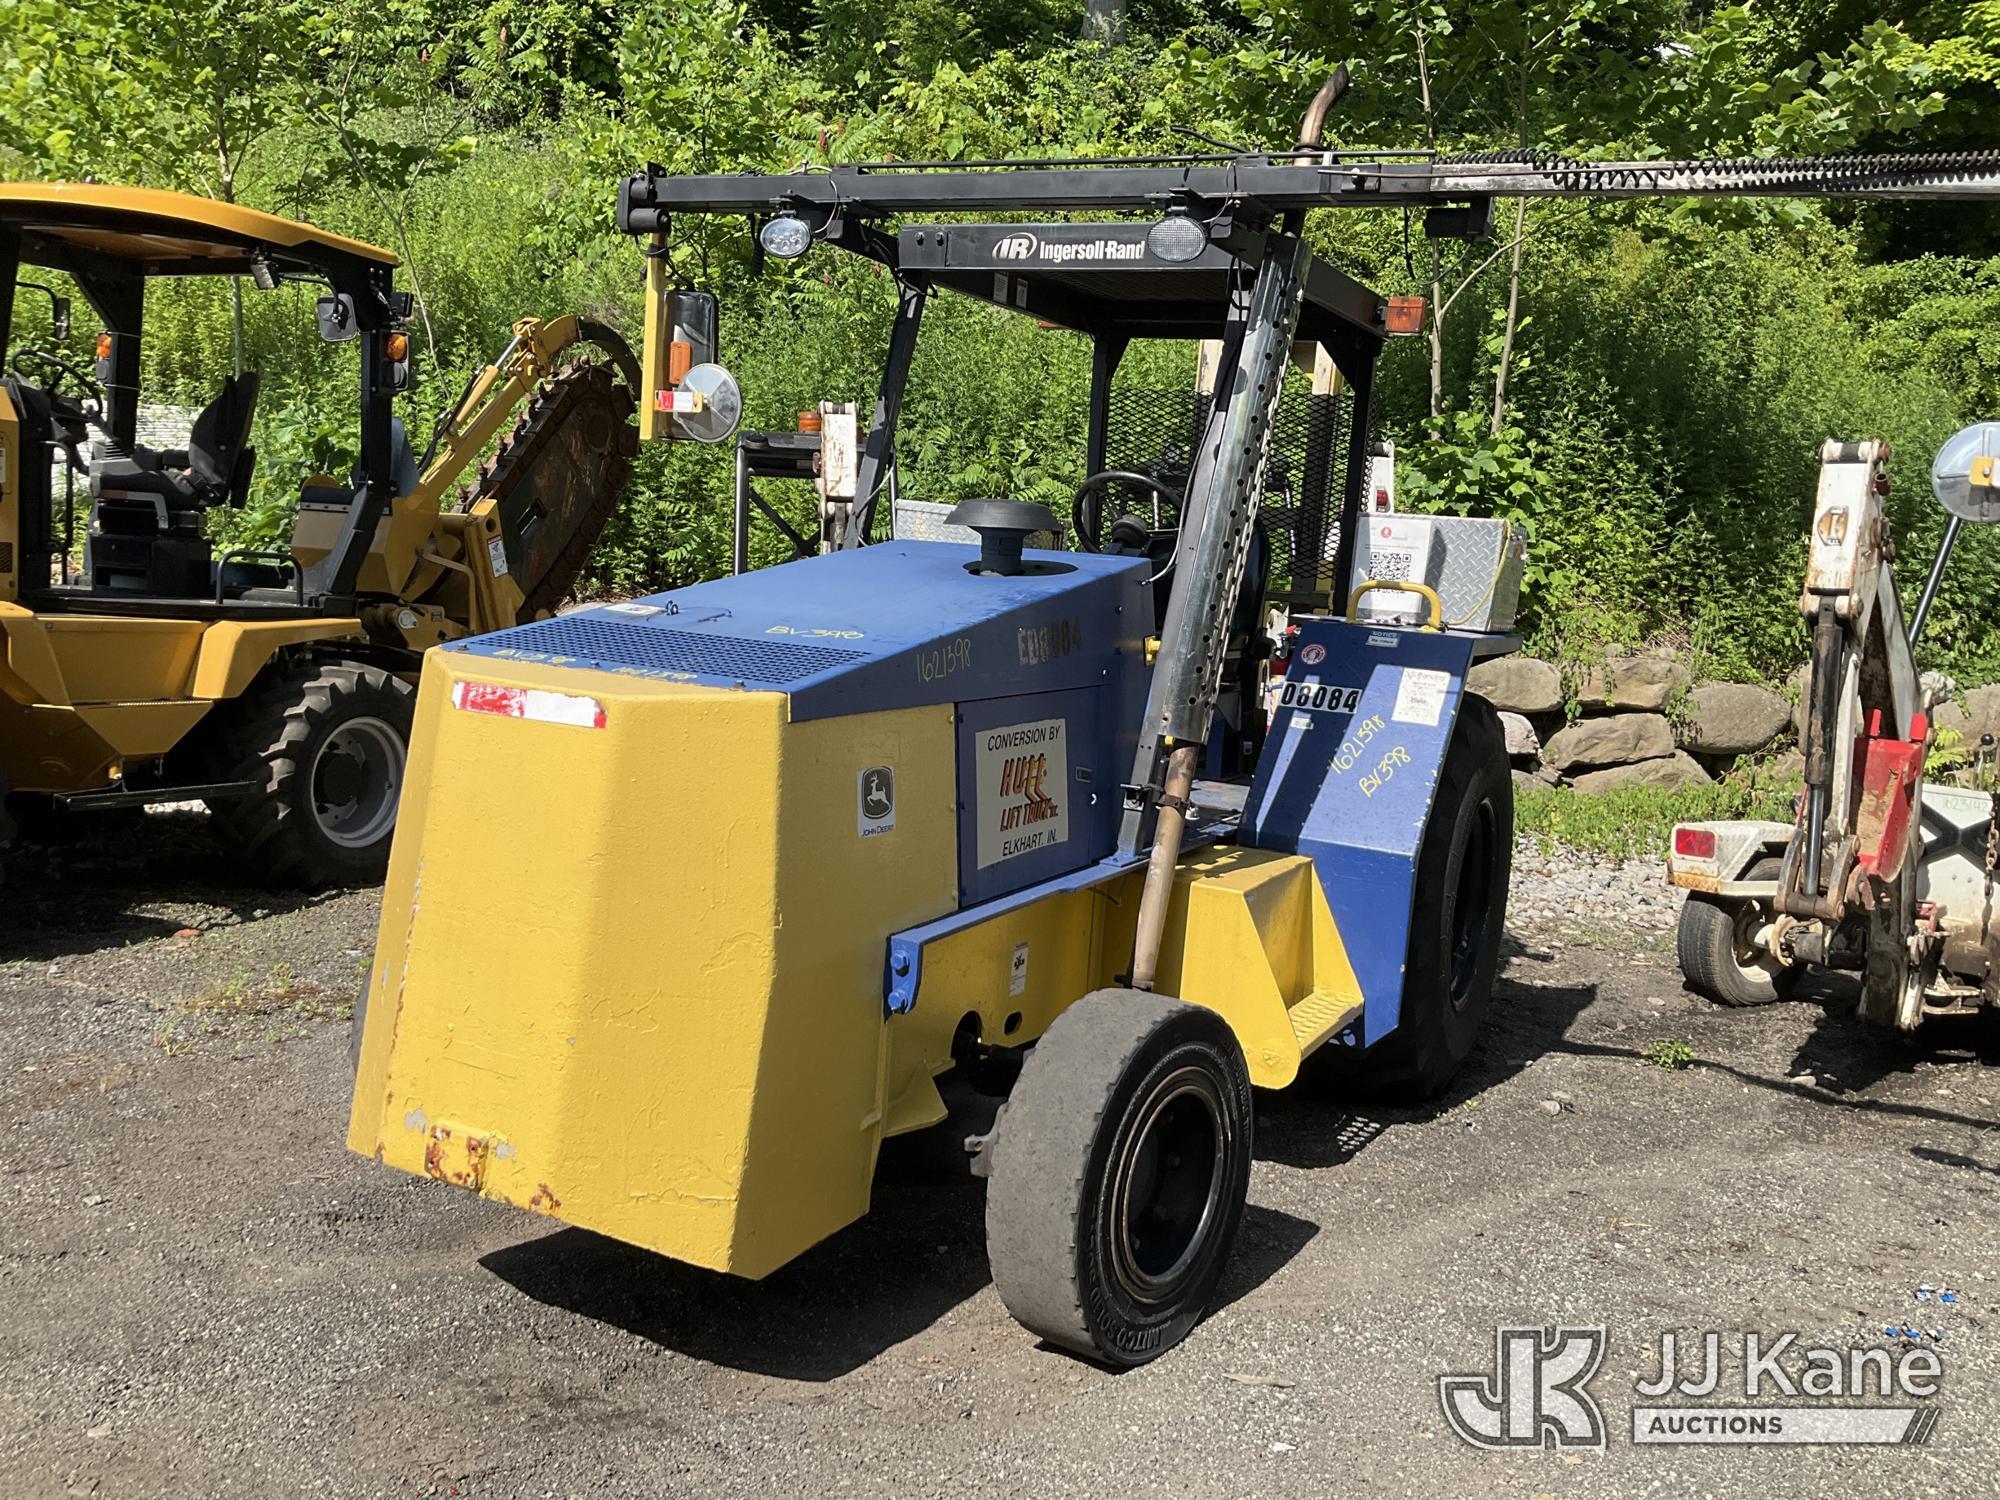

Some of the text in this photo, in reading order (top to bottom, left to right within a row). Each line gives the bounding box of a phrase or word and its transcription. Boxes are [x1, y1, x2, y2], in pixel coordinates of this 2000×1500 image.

[765, 625, 865, 639] BV398
[916, 638, 971, 683] 1621398
[1281, 683, 1358, 712] 08084
[988, 725, 1061, 752] CONVERSION BY
[1329, 714, 1386, 775] 1621398
[1358, 746, 1412, 798] BV398
[1000, 803, 1023, 832] LIFT
